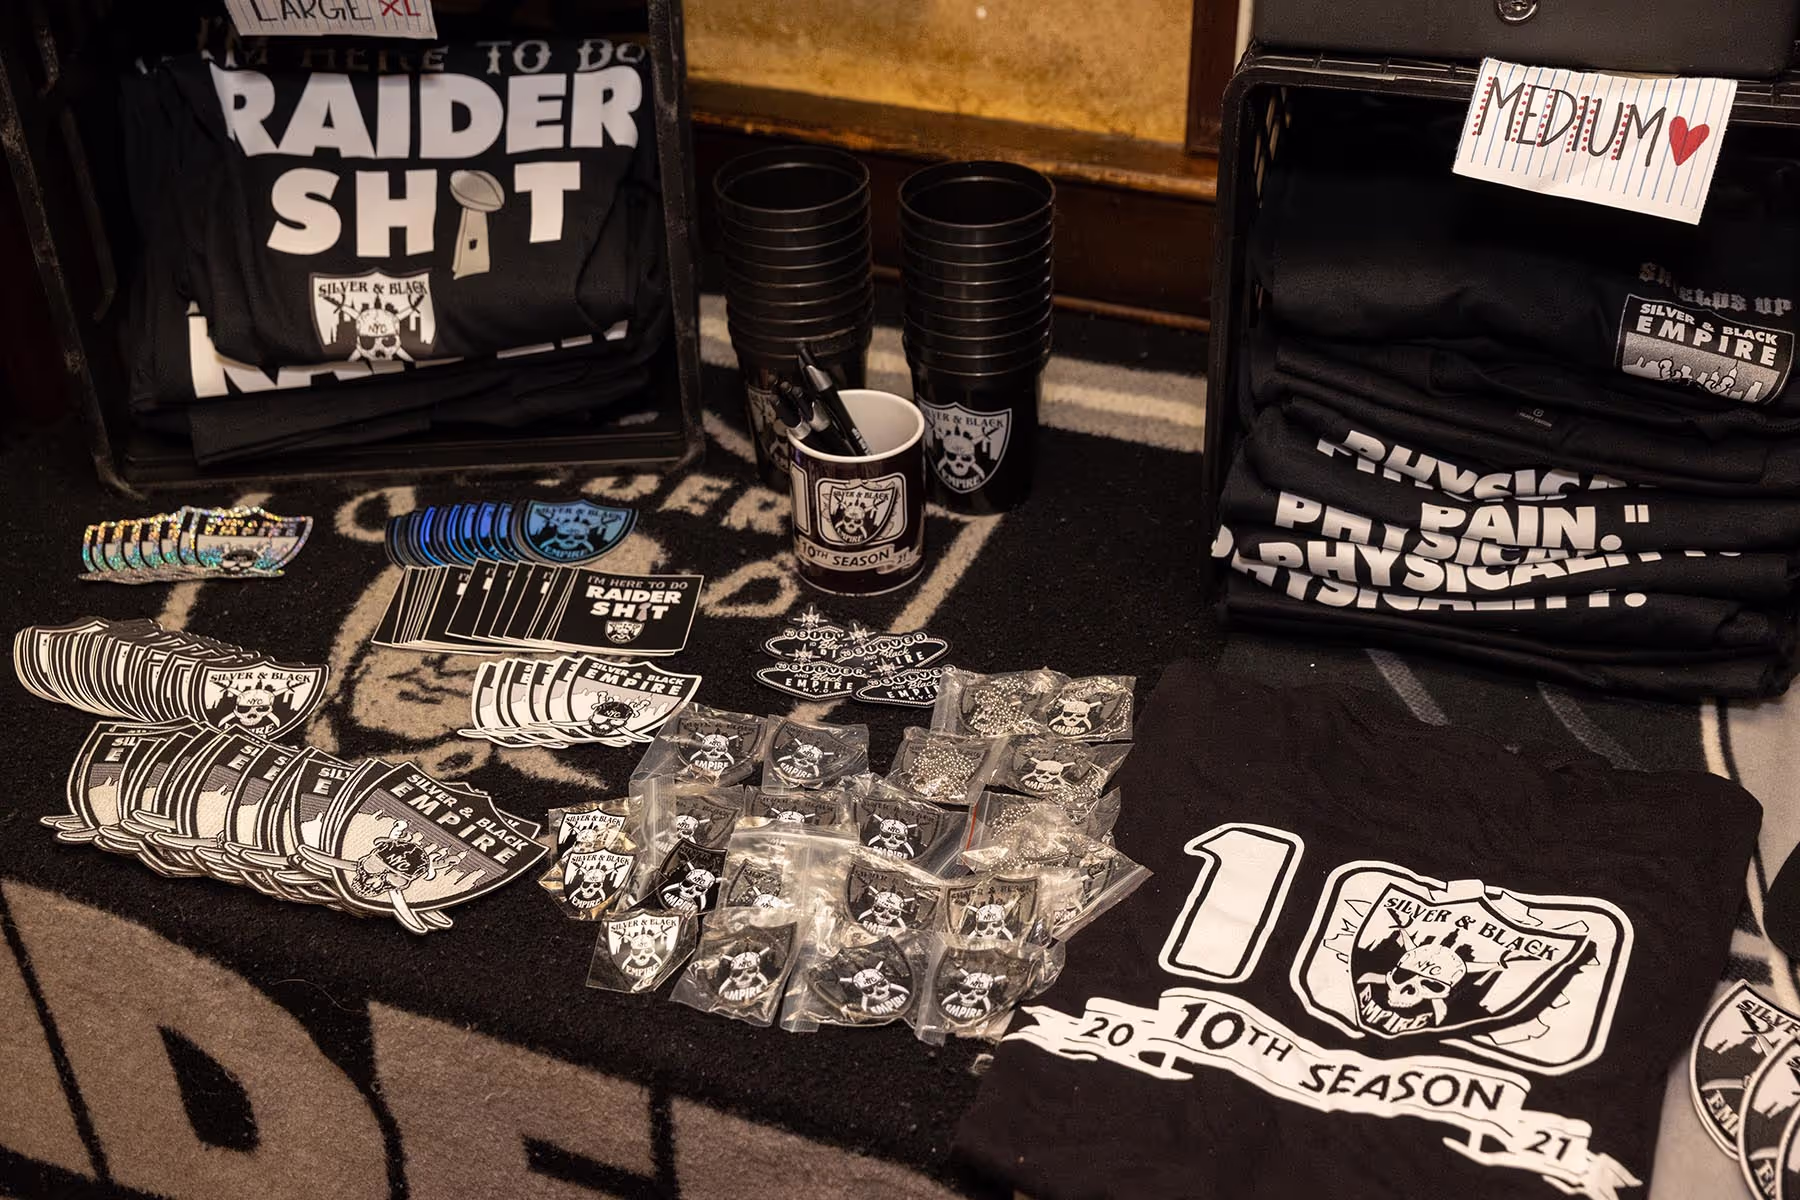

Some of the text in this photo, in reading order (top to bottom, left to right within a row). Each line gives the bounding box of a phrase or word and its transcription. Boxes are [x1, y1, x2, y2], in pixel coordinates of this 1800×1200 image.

[252, 0, 422, 22] LARGE XL
[476, 39, 552, 75] TO
[577, 38, 646, 73] DO
[209, 63, 643, 160] RAIDER
[1472, 75, 1667, 168] MEDIUM
[318, 281, 428, 297] SILVER & BLACK
[1640, 303, 1778, 346] SILVER & BLACK
[1636, 315, 1778, 367] EMPIRE
[966, 416, 1004, 428] BLACK
[864, 491, 891, 501] BLACK
[802, 542, 830, 560] 10TH
[832, 549, 891, 568] SEASON
[587, 575, 689, 591] I'M HERE TO DO
[585, 584, 683, 605] RAIDER
[210, 672, 311, 683] SILVER & BLACK
[590, 662, 630, 677] SILVER
[647, 674, 686, 686] BLACK
[792, 664, 864, 676] SILVER
[810, 672, 843, 682] Black
[884, 667, 952, 685] SILVE
[584, 668, 682, 696] EMPIRE
[785, 678, 854, 690] EMPIRE
[886, 684, 940, 699] EMPI
[694, 759, 729, 771] EMPIRE
[780, 762, 812, 778] EMPIRE
[406, 774, 530, 852] SILVER & BLACK
[565, 814, 591, 824] SILVER
[599, 815, 622, 827] BLACK
[389, 781, 519, 865] EMPIRE
[385, 851, 411, 872] NYC
[571, 854, 597, 864] SILVER
[606, 855, 630, 866] BLACK
[571, 896, 602, 909] EMPIRE
[610, 920, 639, 931] SILVER
[649, 918, 677, 926] BLACK
[1383, 897, 1560, 961] SILVER & BLACK
[1416, 959, 1443, 976] NYC
[870, 993, 907, 1015] EMPIRE
[945, 1004, 983, 1019] EMPIRE
[1358, 983, 1435, 1034] EMPIRE
[1736, 999, 1800, 1035] SILVE
[1080, 1002, 1572, 1162] 20 10TH SEASON 21
